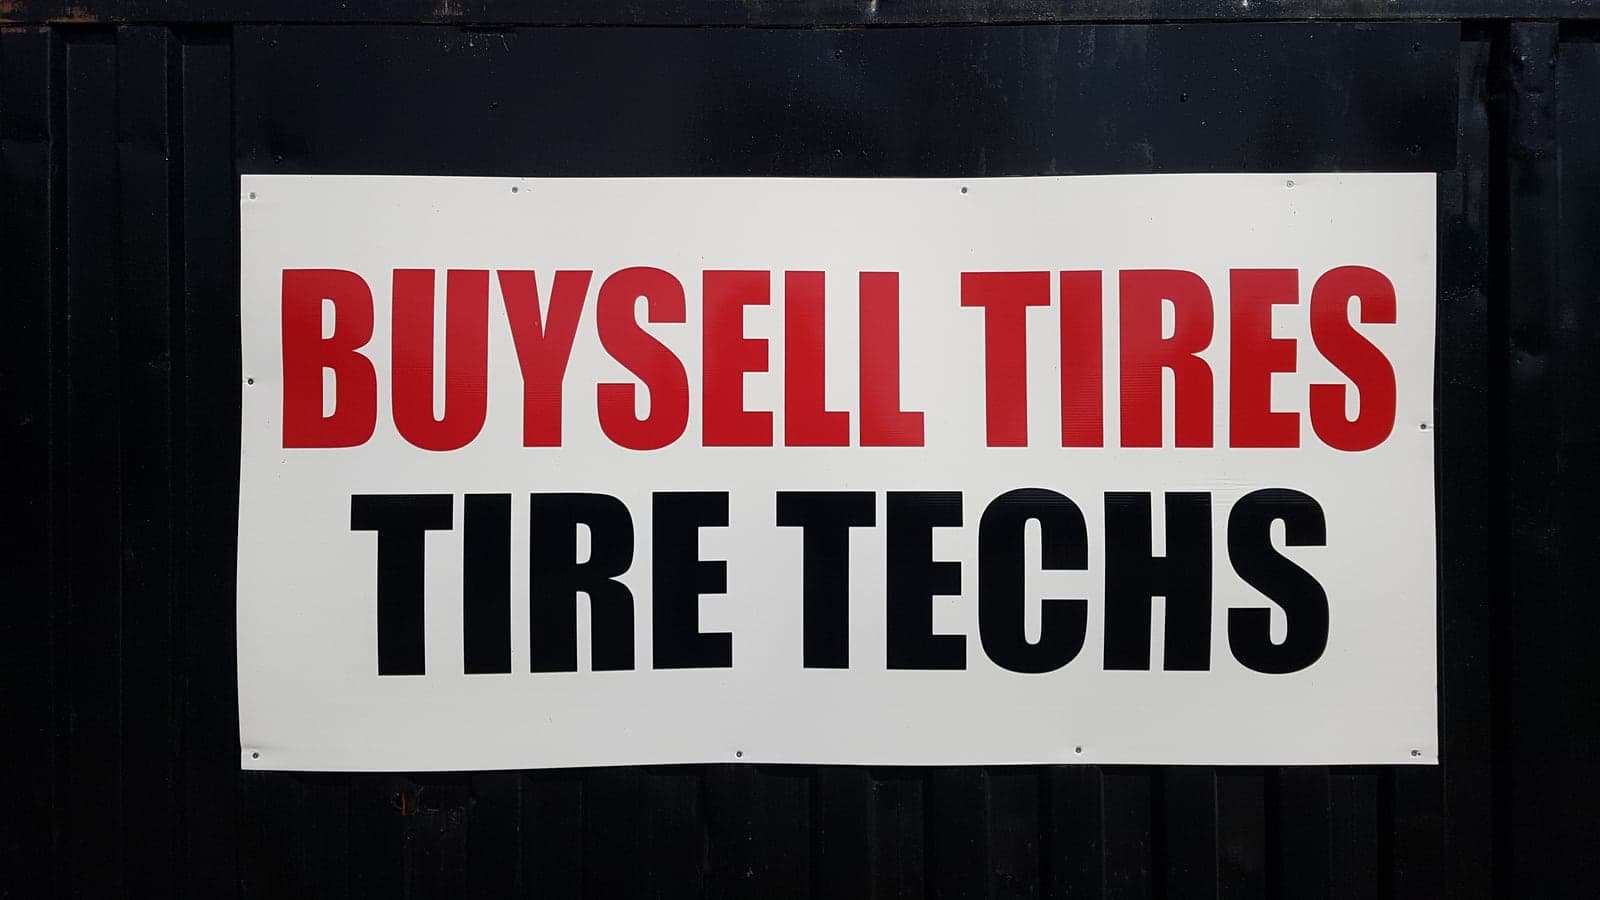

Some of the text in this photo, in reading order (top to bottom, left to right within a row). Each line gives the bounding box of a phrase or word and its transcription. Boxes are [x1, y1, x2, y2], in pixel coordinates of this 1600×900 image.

[282, 266, 1396, 451] BUYSELL TIRES
[351, 488, 1329, 675] TIRE TECHS
